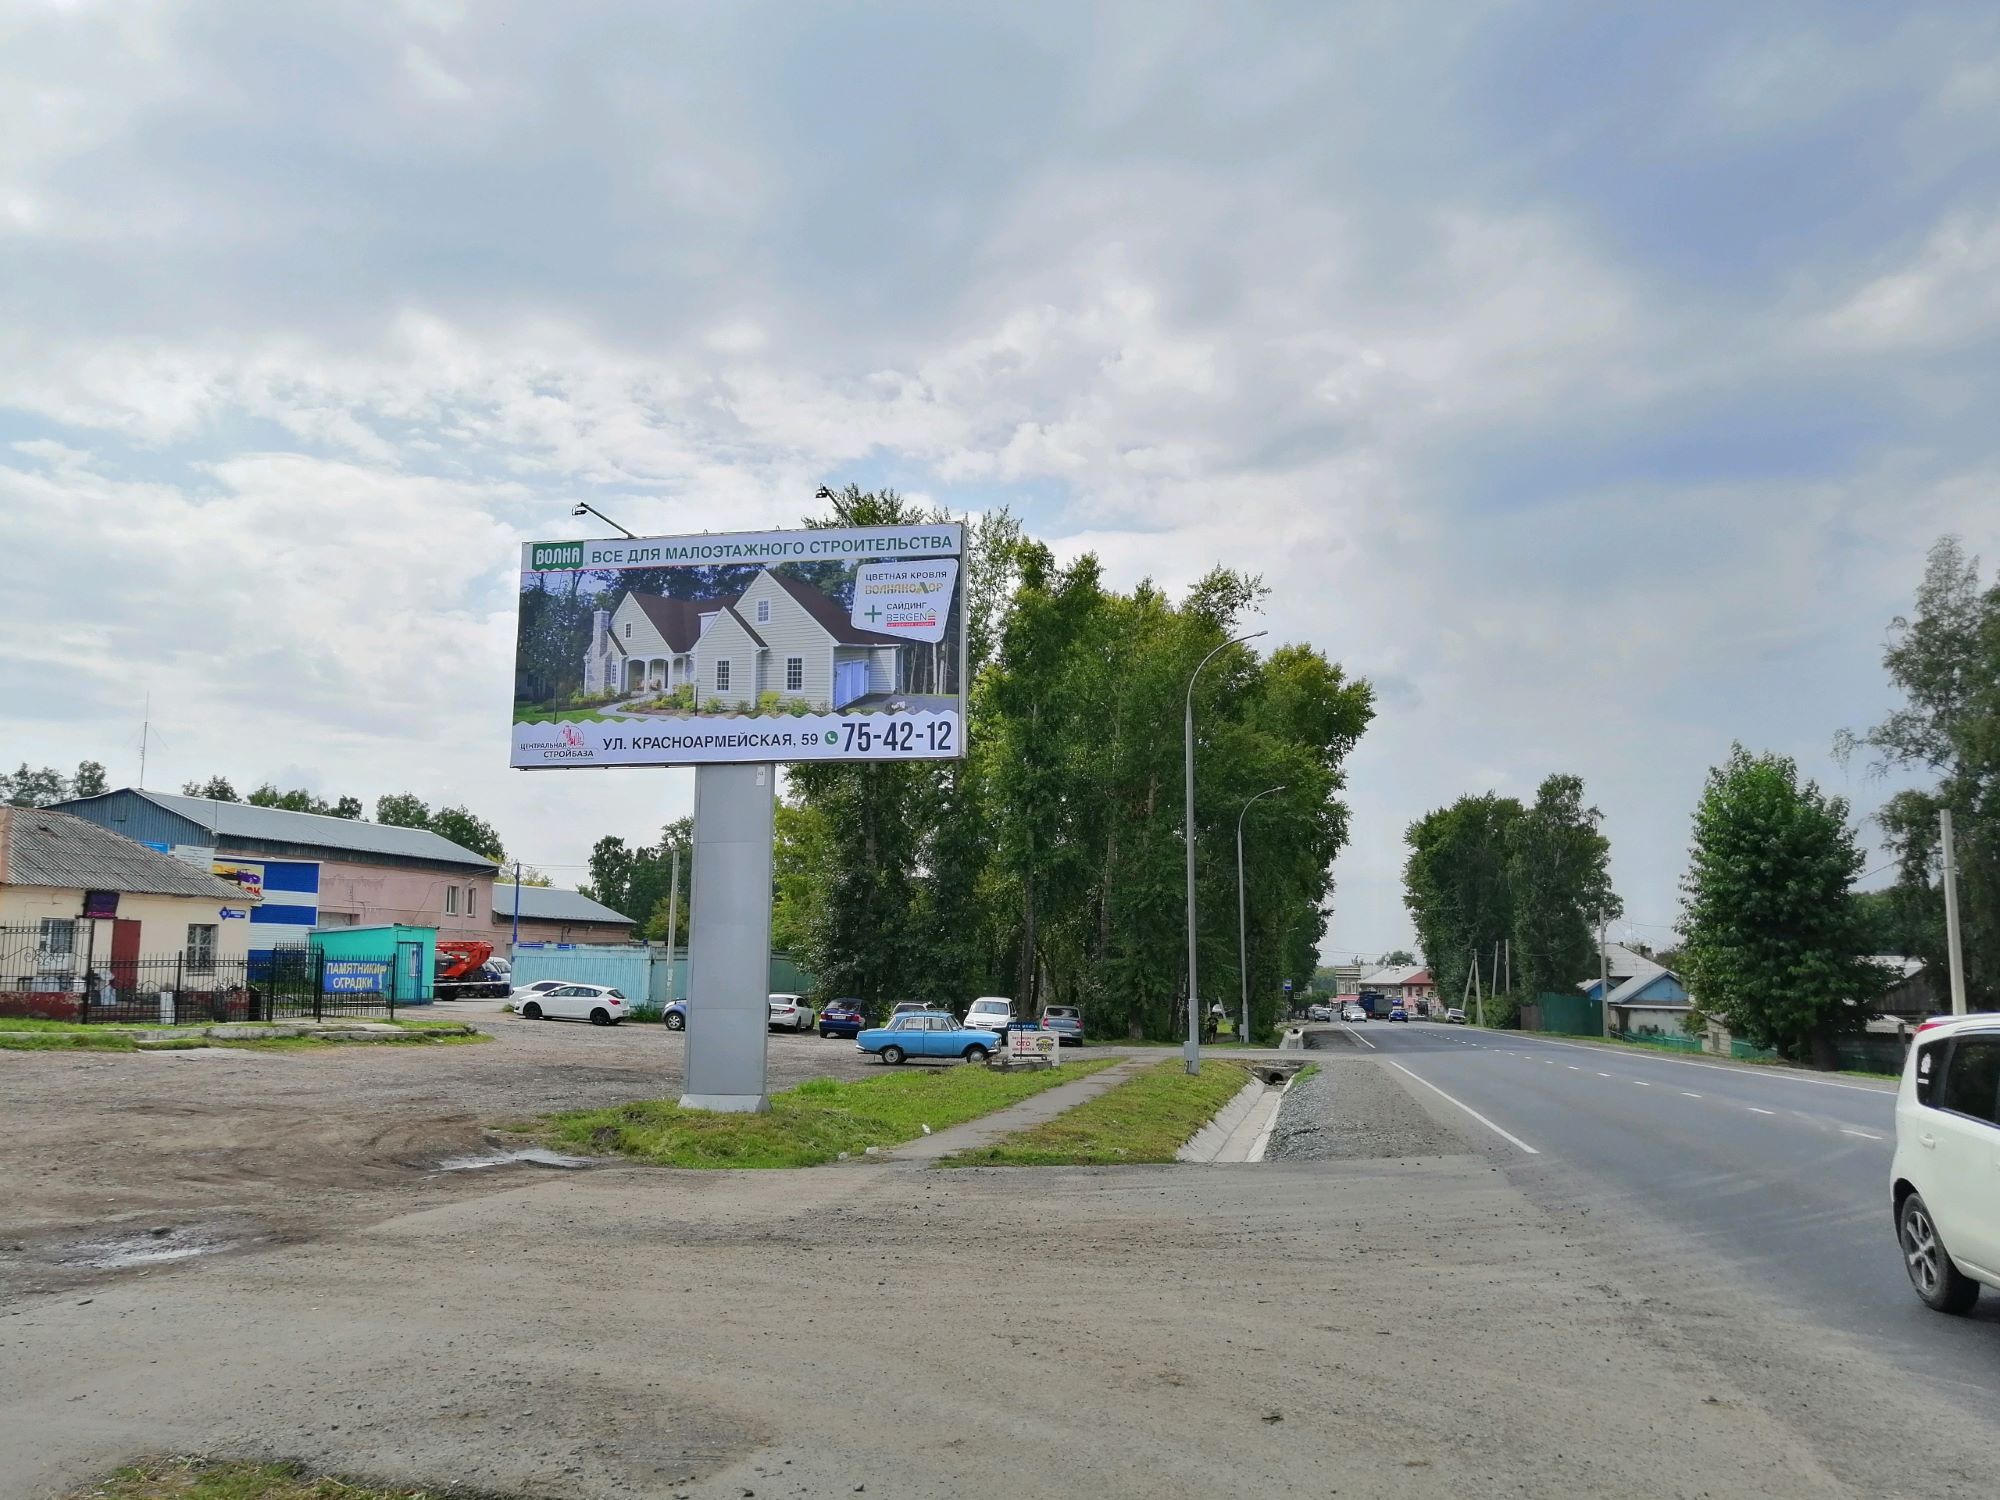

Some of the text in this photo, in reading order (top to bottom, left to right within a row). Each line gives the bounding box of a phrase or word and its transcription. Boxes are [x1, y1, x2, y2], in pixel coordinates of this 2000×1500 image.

[592, 535, 952, 563] ВСЕ ДЛЯ МАЛОЭТАЖНОГО СТРОИТЕЛЬСТВА
[535, 547, 580, 565] ВОЛНА
[865, 571, 947, 581] ЦВЕТНАЯ КРОВЛЯ
[886, 602, 927, 610] САЙДИНГ
[886, 612, 927, 621] BERGEN
[603, 731, 818, 750] УЛ. КРАСНОАРМЕЙСКАЯ, 59
[841, 721, 952, 752] 75-42-12
[520, 742, 567, 750] ЦЕНТРАЛЬНАЯ
[543, 748, 594, 758] СТРОЙБАЗА
[326, 962, 380, 975] ПАМЯТНИКИ
[333, 977, 373, 991] ОГРАДКИ
